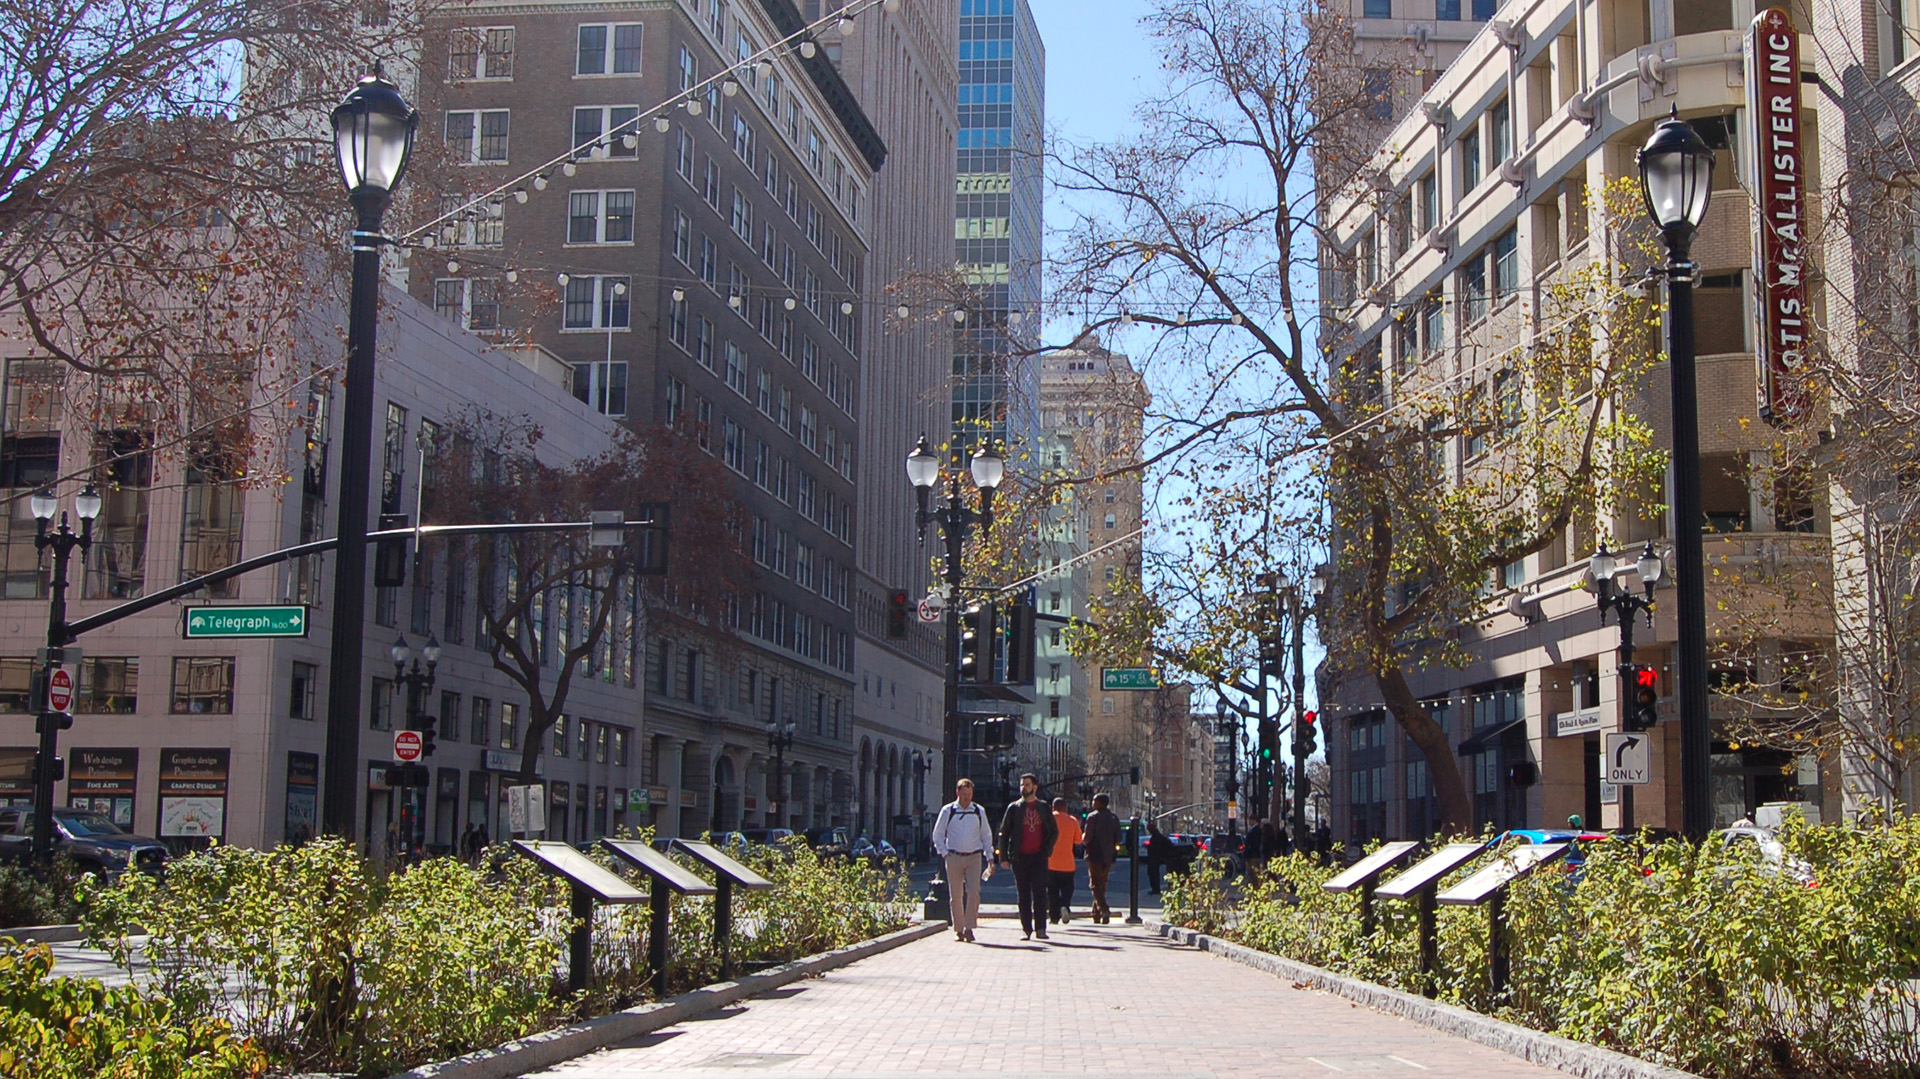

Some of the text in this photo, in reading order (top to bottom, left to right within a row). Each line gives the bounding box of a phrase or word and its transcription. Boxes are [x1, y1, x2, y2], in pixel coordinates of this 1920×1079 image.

[1769, 33, 1791, 84] INC
[1780, 298, 1804, 369] OTIS
[208, 615, 270, 631] Telegraph
[83, 753, 122, 766] Web design
[172, 754, 217, 766] Graphic design
[1612, 769, 1643, 780] ONLY
